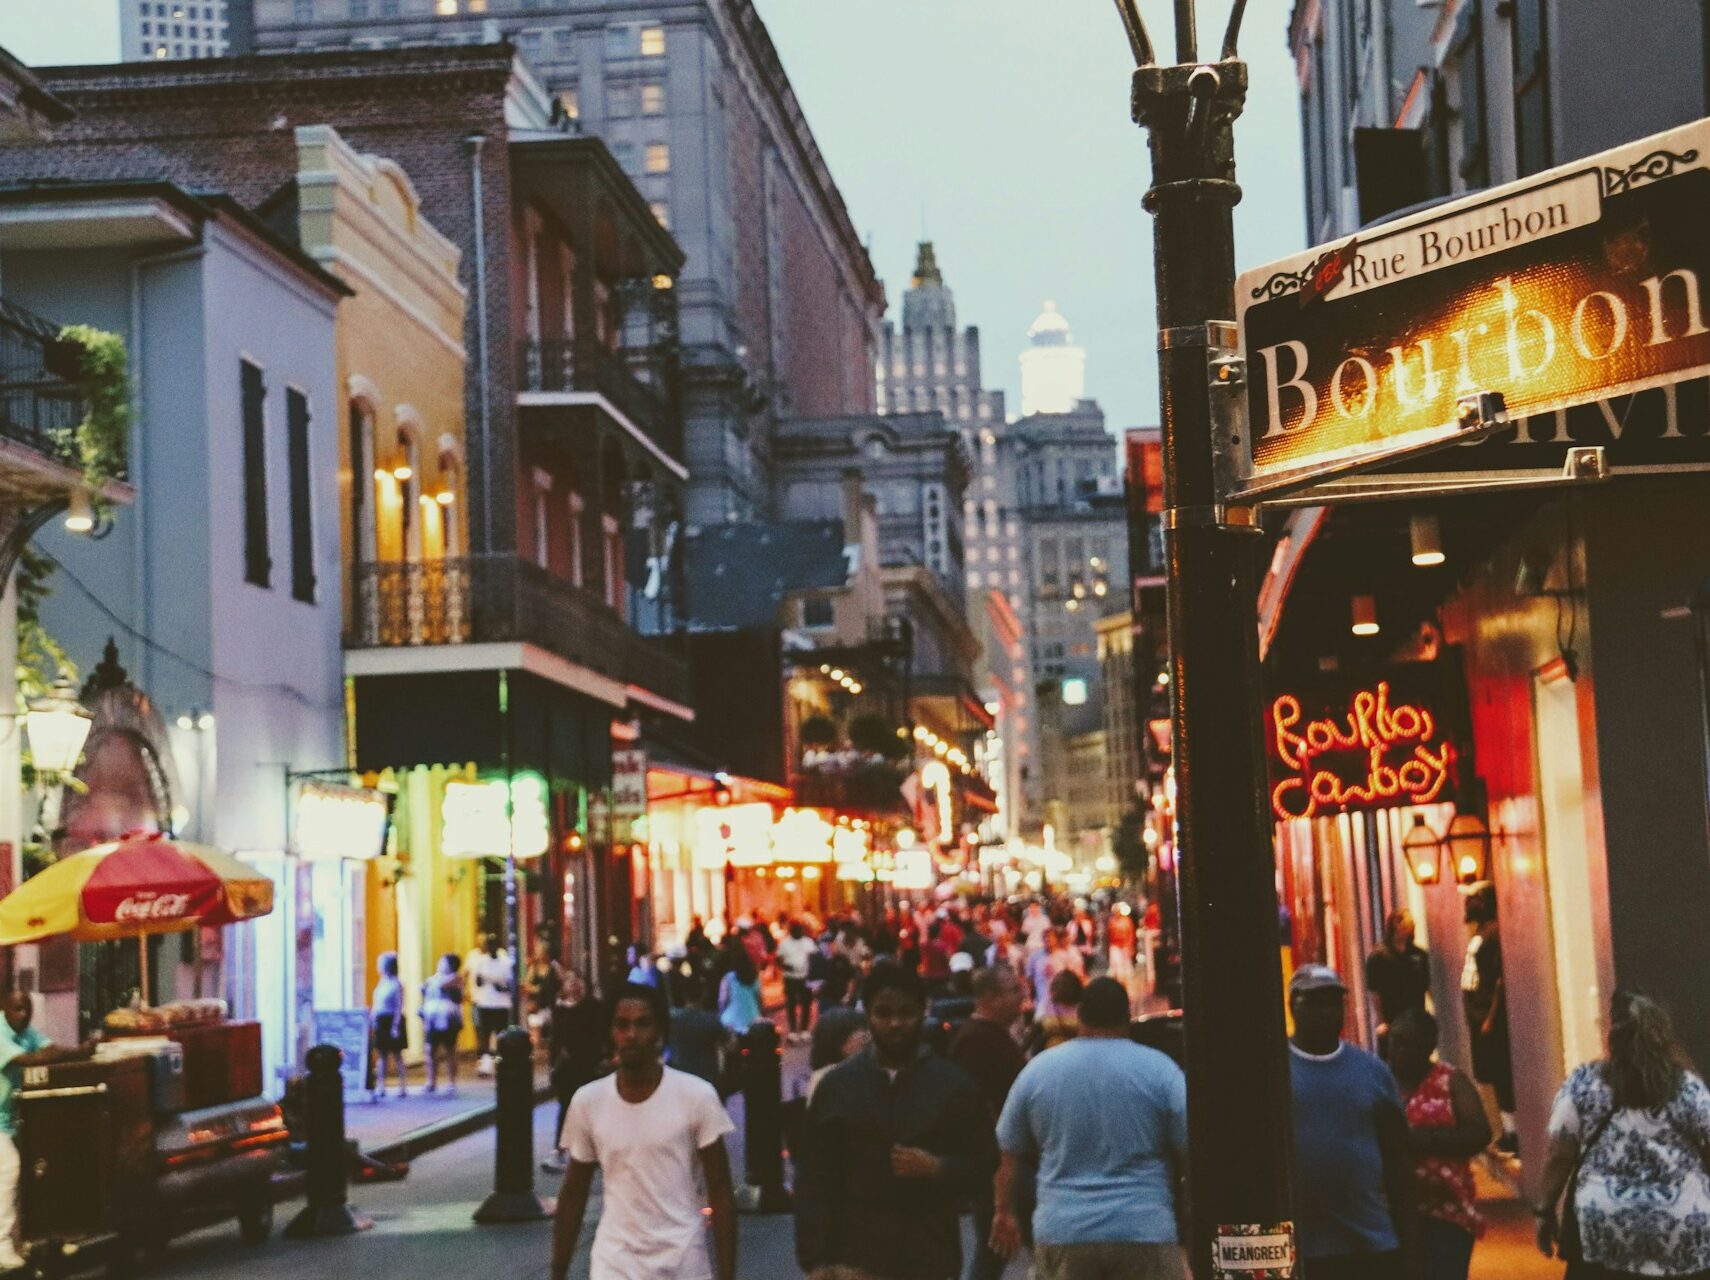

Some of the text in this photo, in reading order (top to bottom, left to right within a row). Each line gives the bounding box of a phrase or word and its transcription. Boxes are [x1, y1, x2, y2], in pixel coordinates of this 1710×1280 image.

[1350, 201, 1569, 288] Rue Bourbon
[1257, 268, 1710, 439] Bourbon
[1222, 1245, 1287, 1261] MEANGREEN
